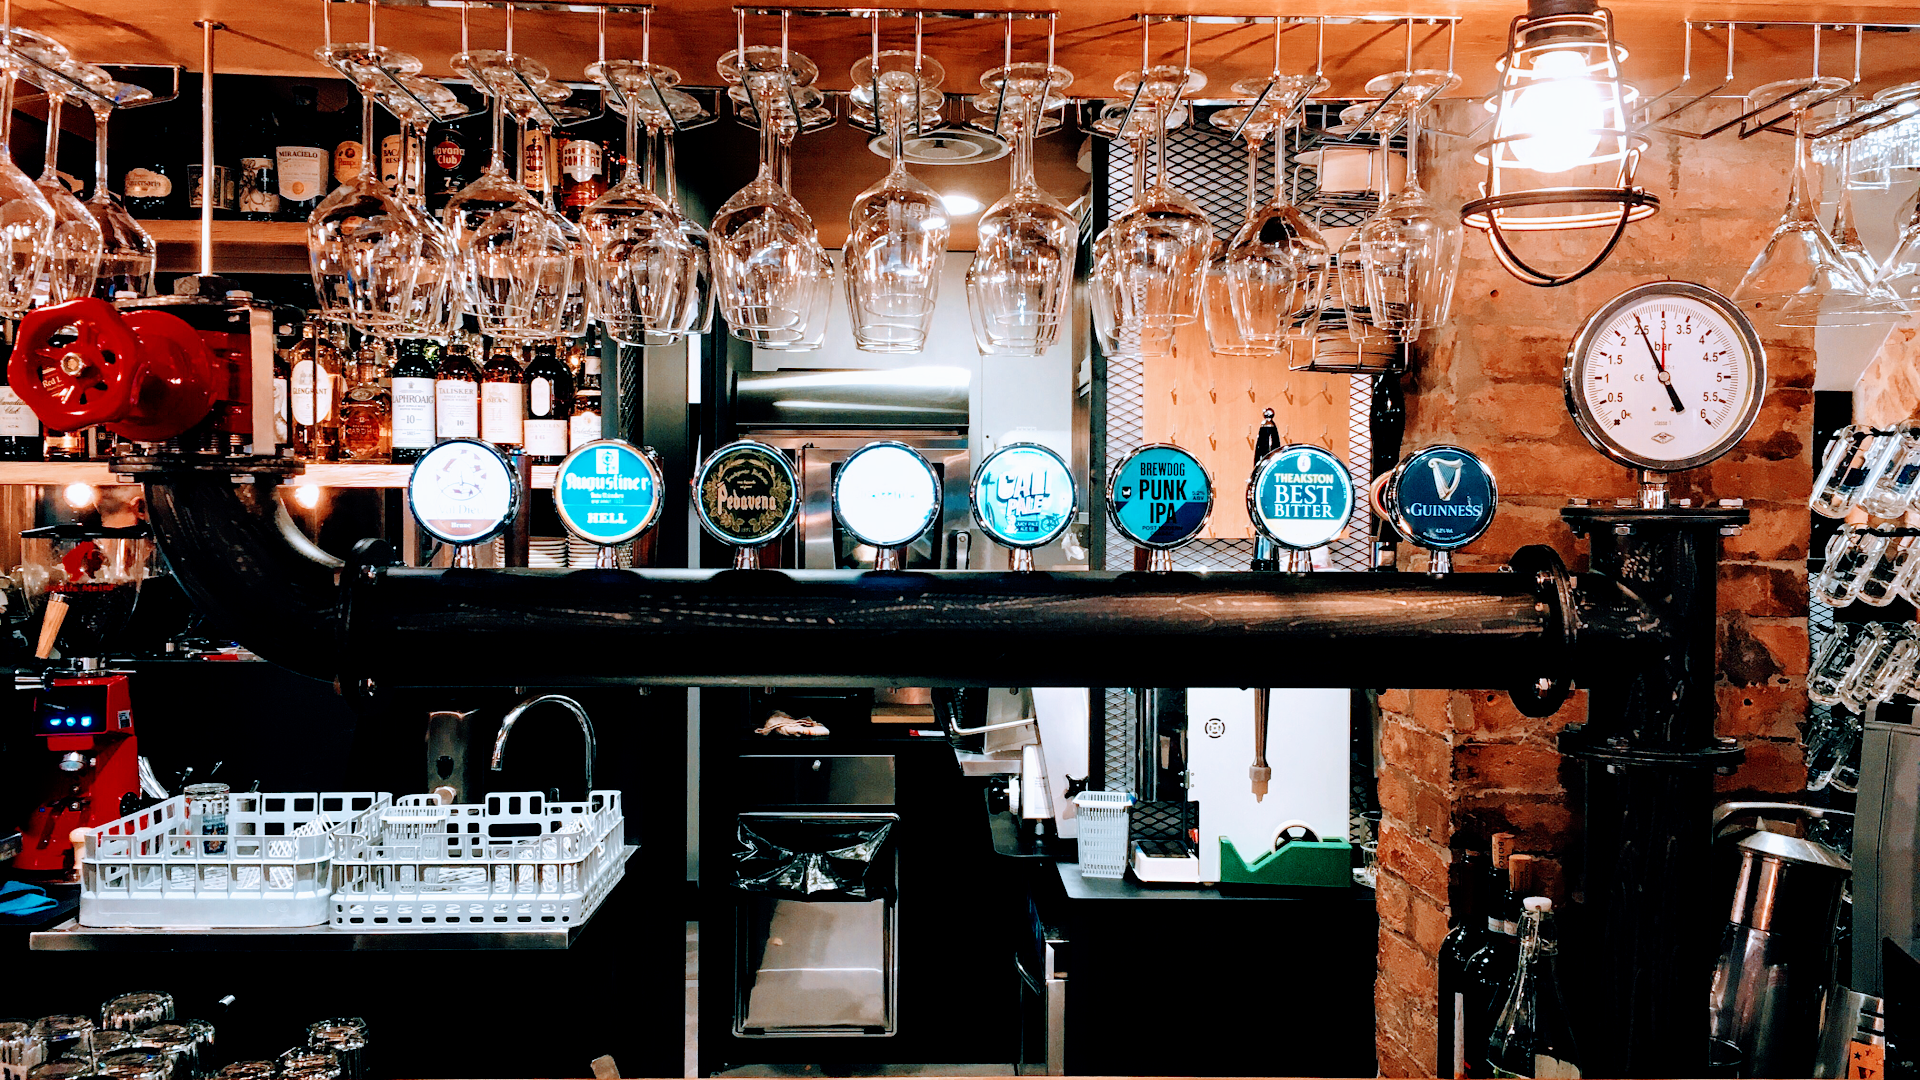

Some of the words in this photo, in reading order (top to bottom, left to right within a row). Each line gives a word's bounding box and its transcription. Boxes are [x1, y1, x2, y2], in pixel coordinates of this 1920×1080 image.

[279, 151, 318, 159] MIRACIELO
[433, 145, 465, 156] Havana
[437, 156, 458, 165] Club
[564, 155, 601, 167] COMFRT
[444, 176, 451, 187] 7
[1660, 320, 1667, 330] 3
[1676, 324, 1692, 335] 3.5
[1620, 336, 1627, 347] 2
[1698, 335, 1705, 345] 4
[1654, 341, 1673, 351] bar
[1608, 354, 1623, 365] 1.5
[1702, 352, 1719, 362] 4.5
[1604, 373, 1609, 383] 1
[1716, 372, 1723, 382] 5
[42, 378, 57, 388] Red
[1607, 392, 1623, 402] 0.5
[1703, 392, 1719, 402] 5.5
[1621, 409, 1627, 419] 0
[1700, 409, 1706, 418] 6
[406, 415, 416, 424] 10
[1140, 462, 1185, 477] BREWDOG
[565, 472, 649, 491] Augustiner
[1274, 473, 1334, 484] THEAKSTON
[996, 470, 1050, 503] CALI
[1139, 479, 1188, 501] PUNK
[717, 481, 777, 515] Pedavena
[1274, 485, 1333, 505] BEST
[1006, 494, 1043, 518] PALE
[1274, 504, 1334, 518] BITTER
[1410, 503, 1482, 518] GUINNESS
[587, 512, 628, 524] HELL
[1149, 502, 1177, 524] IPA
[451, 521, 471, 529] Brune
